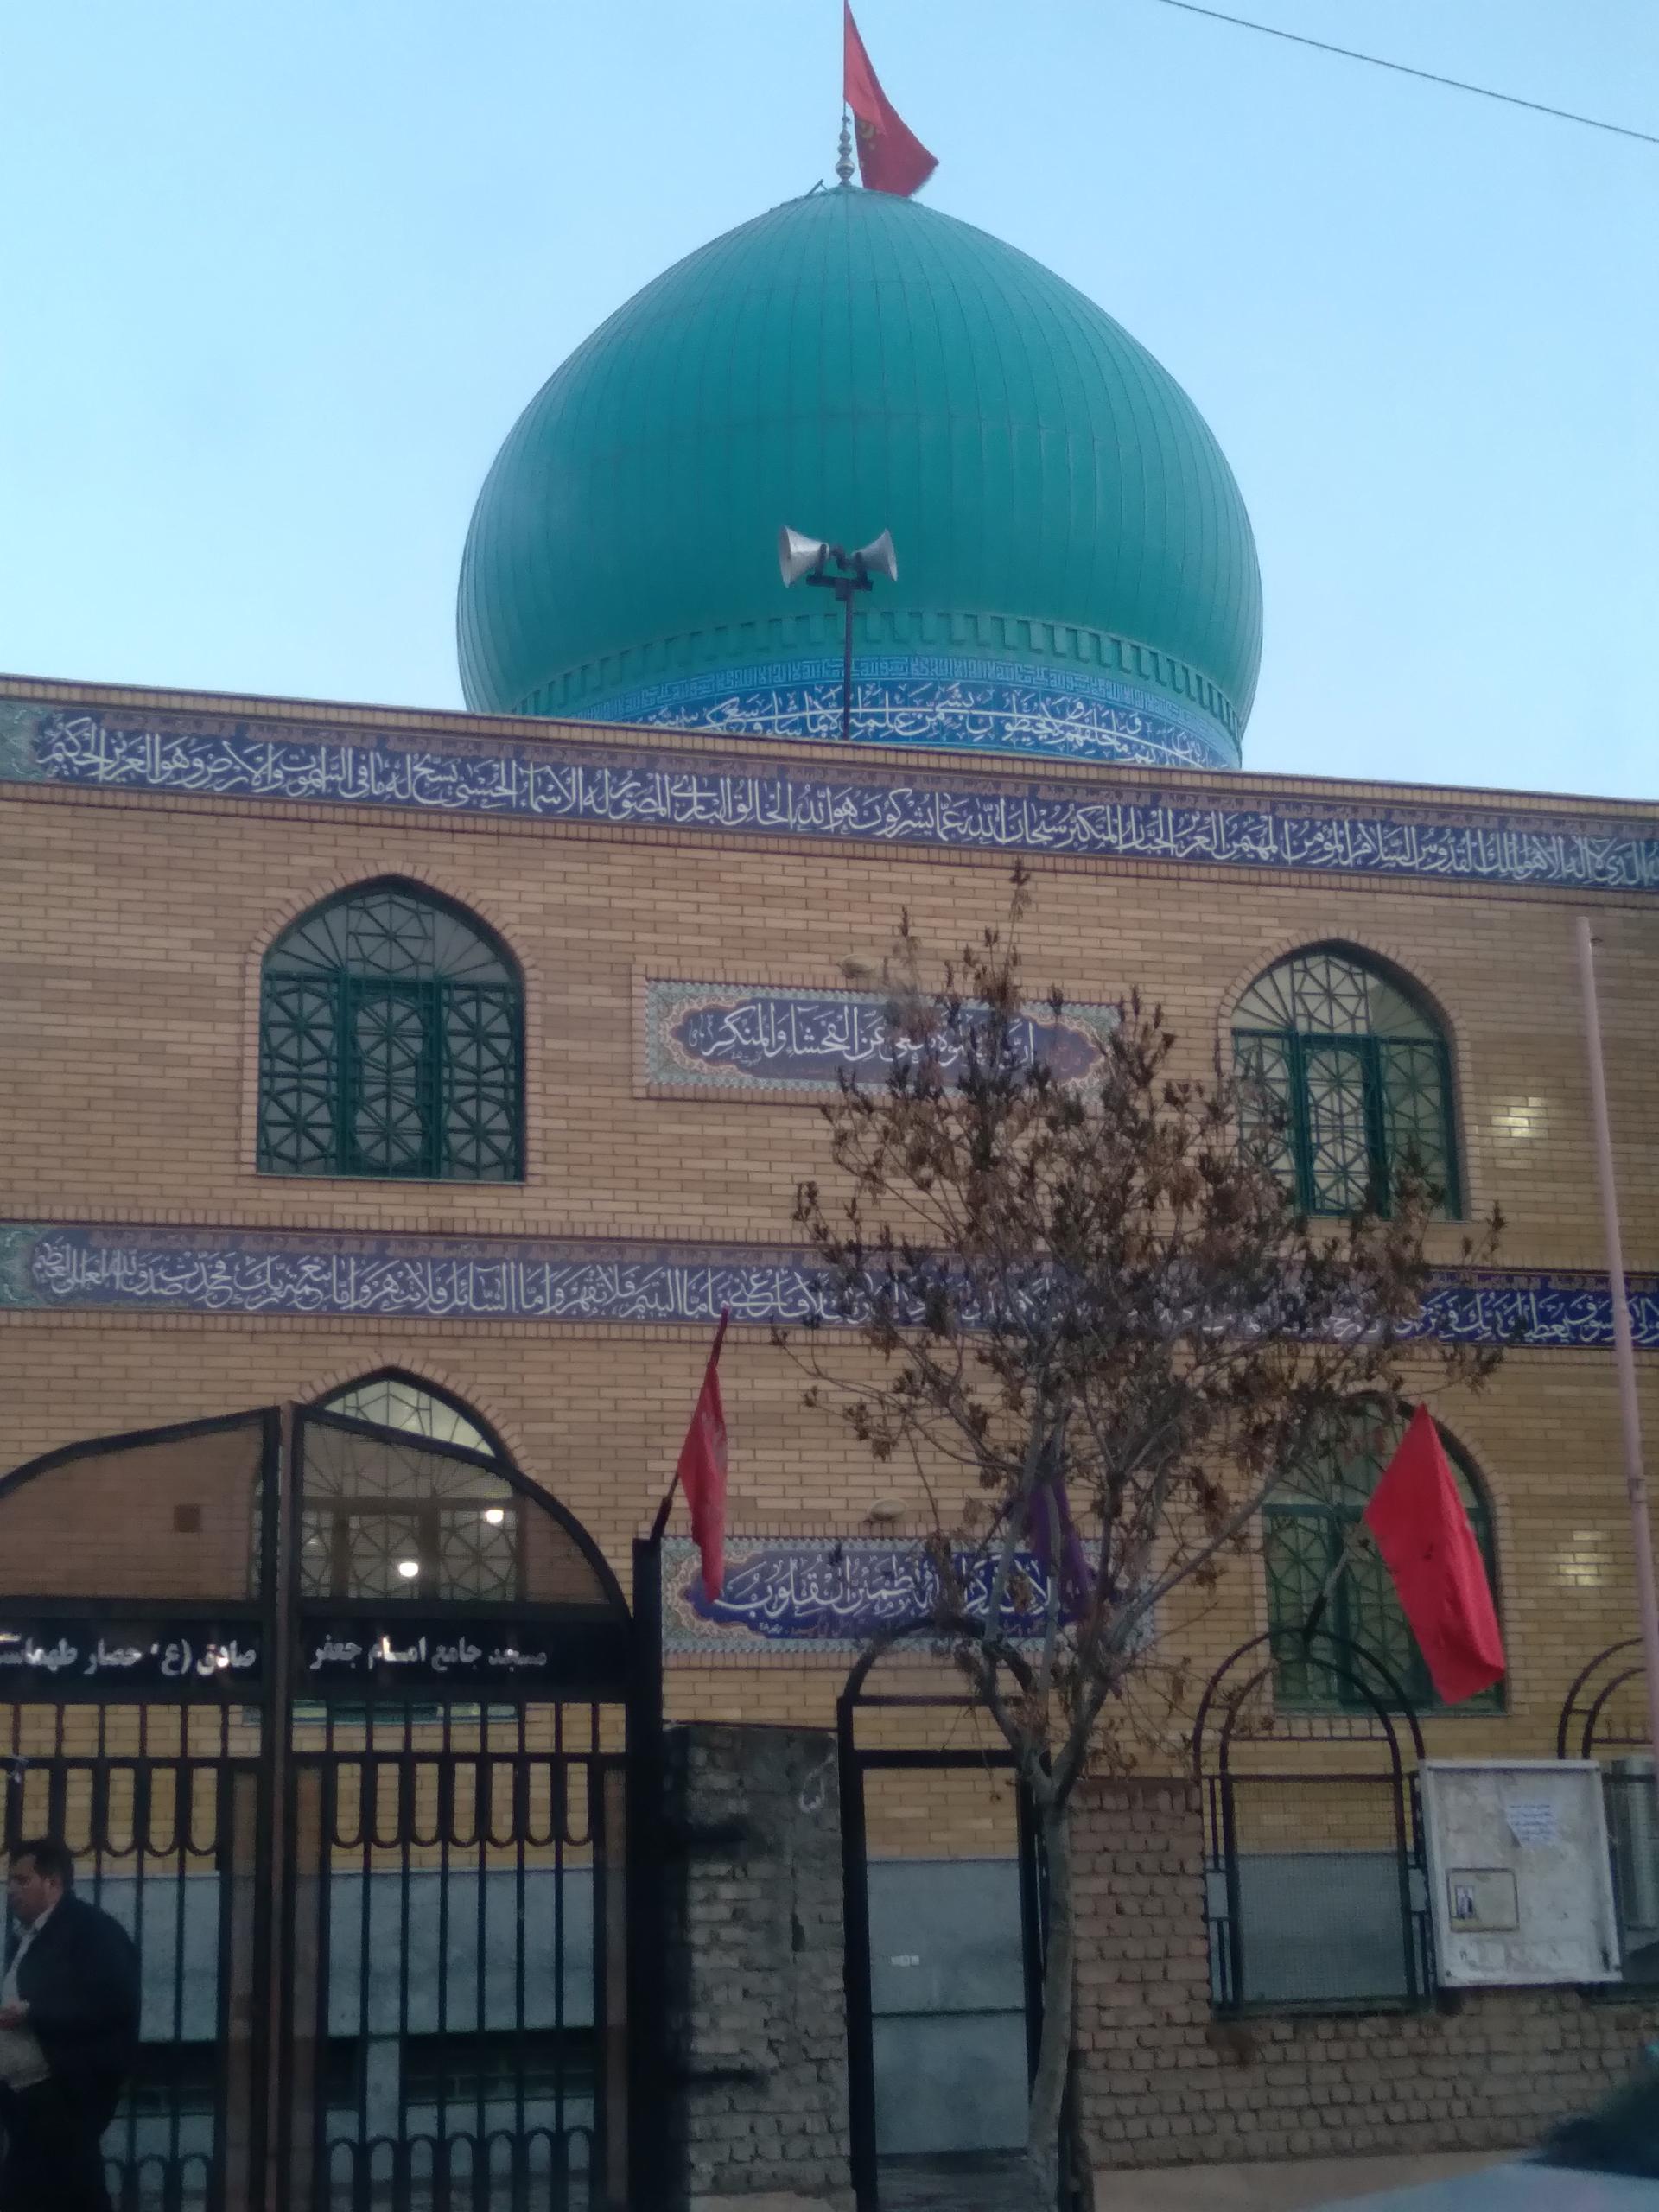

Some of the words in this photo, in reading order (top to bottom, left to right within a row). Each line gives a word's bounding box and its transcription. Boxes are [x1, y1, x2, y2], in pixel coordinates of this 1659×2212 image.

[309, 1633, 363, 1669] جعفر
[367, 1635, 427, 1673] امام
[431, 1636, 483, 1672] جامع
[489, 1647, 548, 1674] مسجد
